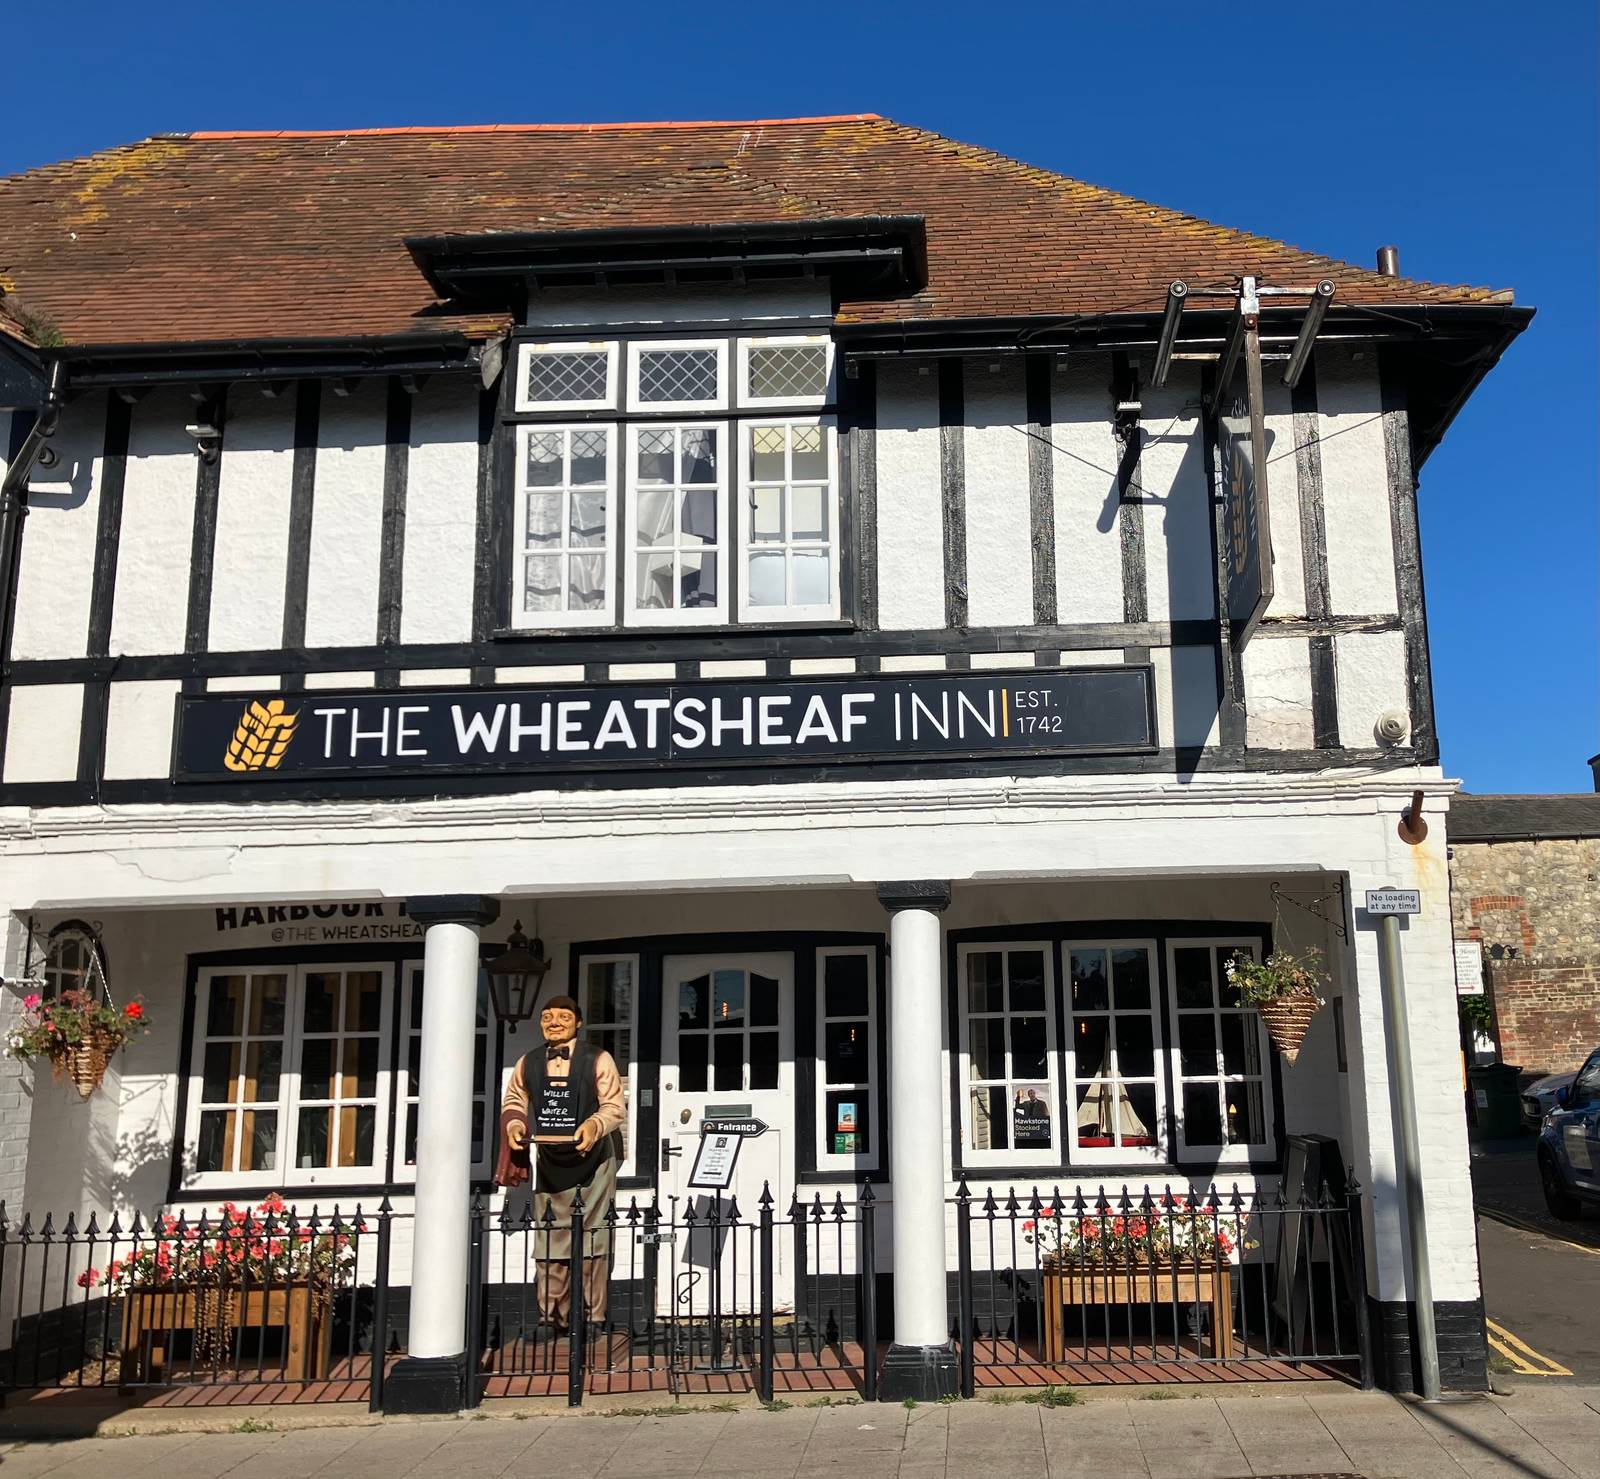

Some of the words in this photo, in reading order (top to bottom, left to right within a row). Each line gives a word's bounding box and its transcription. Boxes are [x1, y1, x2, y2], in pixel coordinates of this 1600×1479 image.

[1015, 690, 1058, 708] EST.
[313, 705, 430, 758] THE
[451, 692, 876, 754] WHEATSHEAF
[894, 689, 996, 741] INN
[1016, 715, 1063, 734] 1742
[1370, 894, 1383, 902] No
[1386, 894, 1416, 903] loading
[271, 926, 318, 943] @THE
[543, 1089, 571, 1098] WILLIE
[541, 1107, 569, 1116] WAITER
[717, 1123, 757, 1132] Entrance
